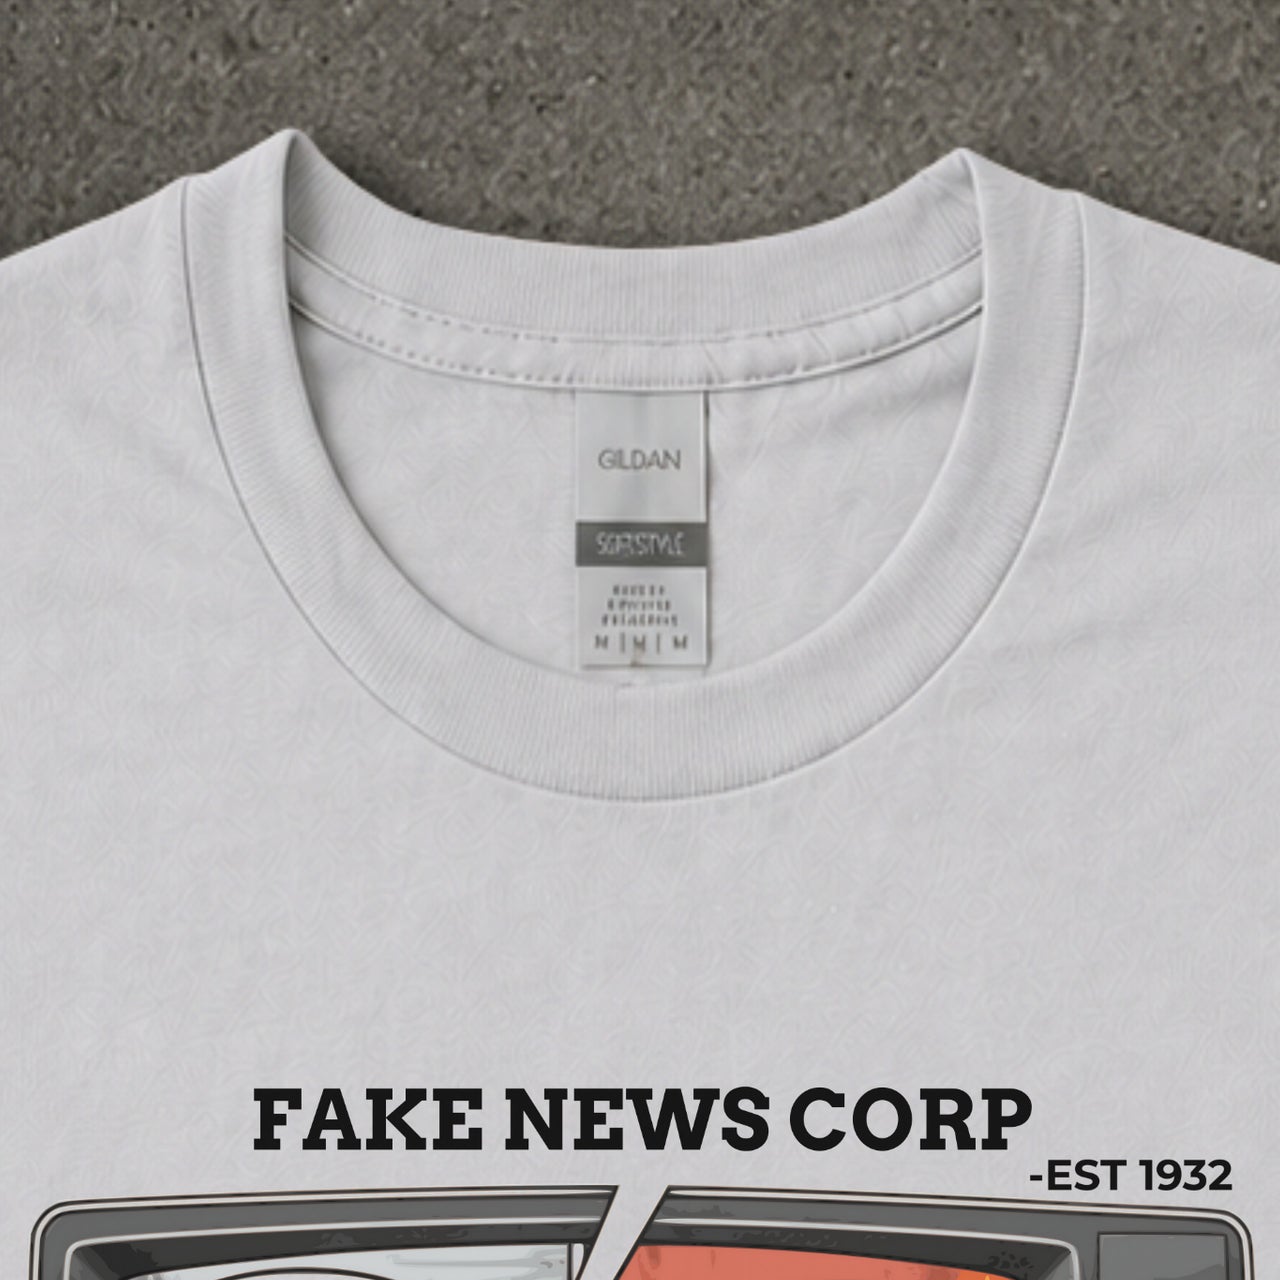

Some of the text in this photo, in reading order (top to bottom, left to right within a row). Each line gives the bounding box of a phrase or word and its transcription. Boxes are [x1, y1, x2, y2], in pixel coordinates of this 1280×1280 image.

[597, 448, 682, 471] GILDAN
[253, 1086, 1033, 1152] FAKE NEWS CORP
[1029, 1159, 1233, 1191] -EST 1932
